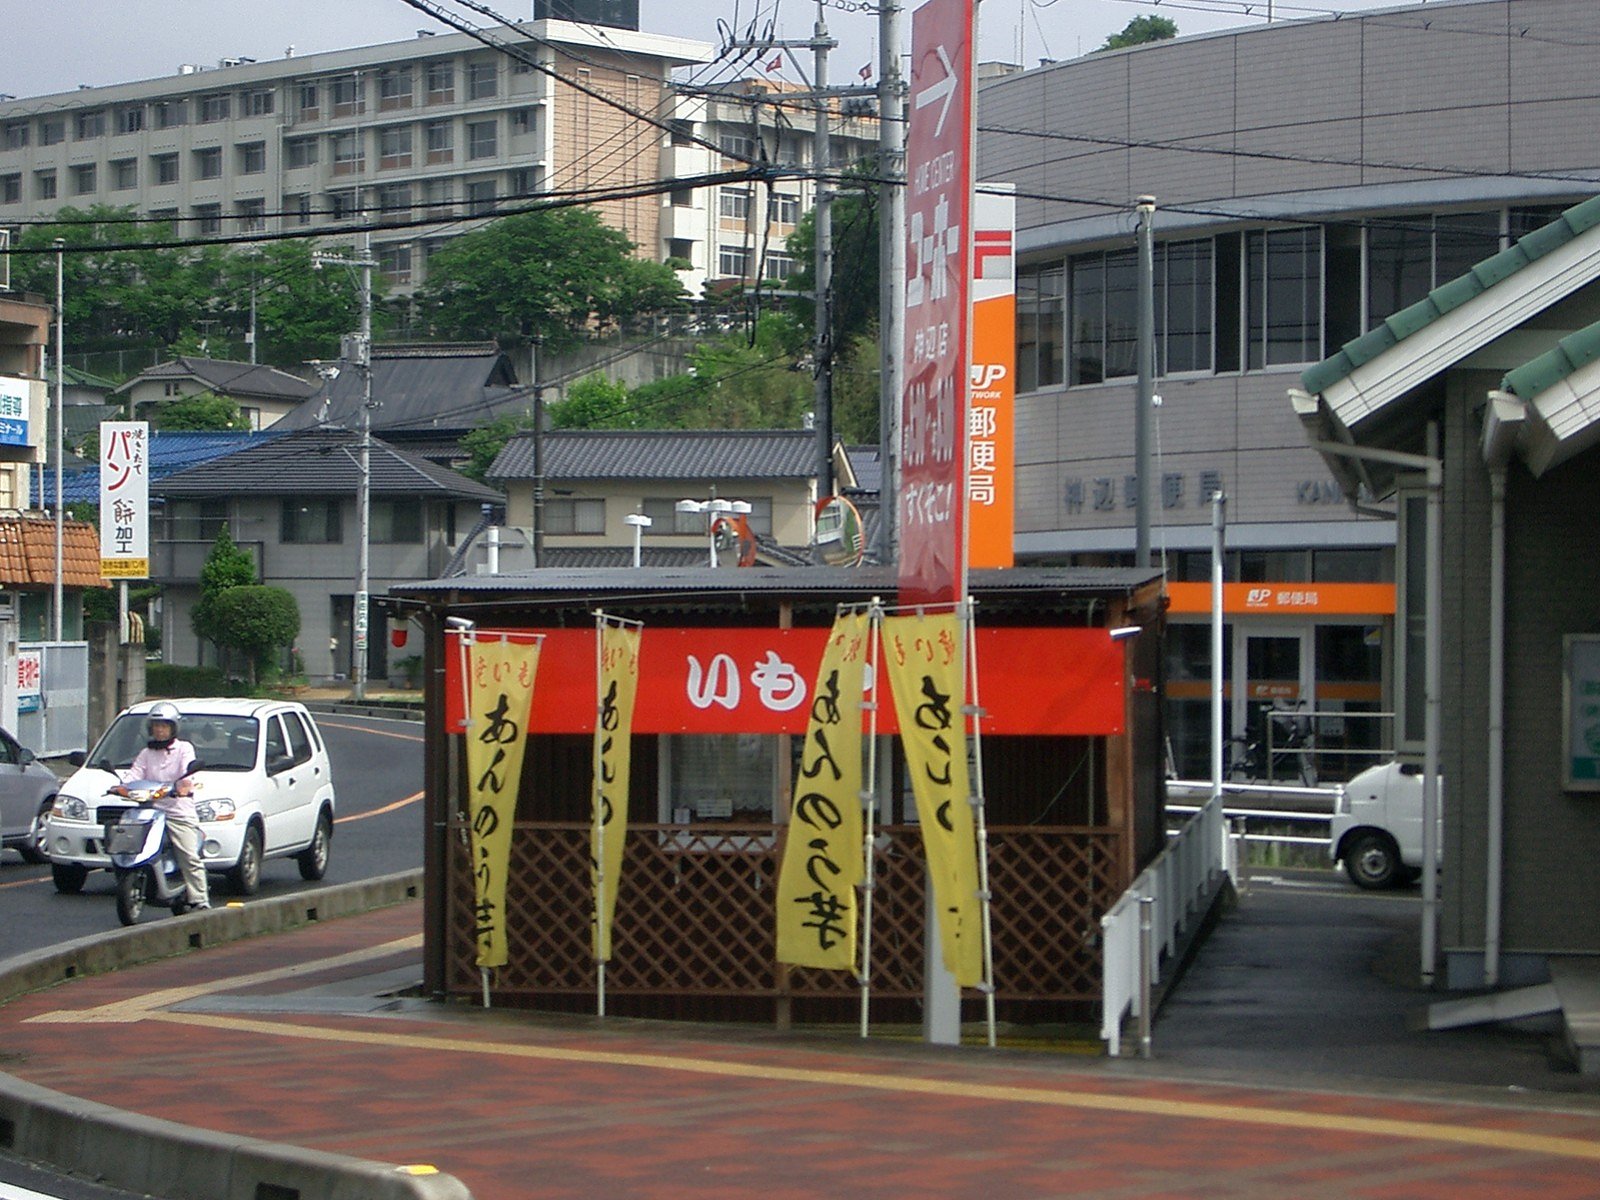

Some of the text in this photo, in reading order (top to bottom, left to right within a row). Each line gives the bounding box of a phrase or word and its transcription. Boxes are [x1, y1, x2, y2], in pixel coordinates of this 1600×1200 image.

[107, 431, 132, 491] パン
[969, 406, 996, 505] 郵便局
[113, 498, 136, 554] 餅加工
